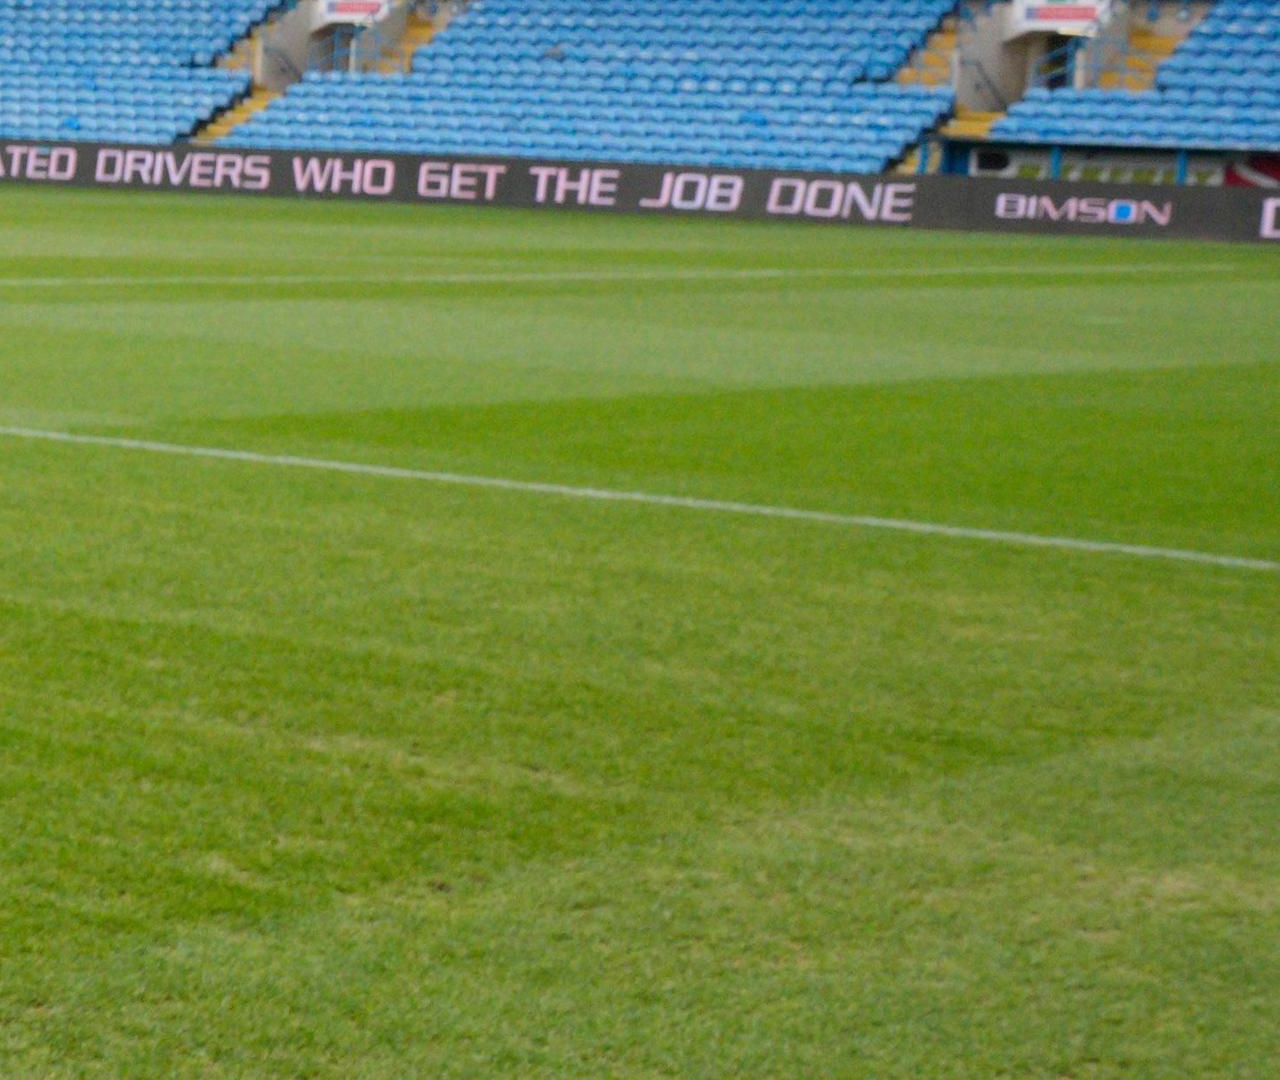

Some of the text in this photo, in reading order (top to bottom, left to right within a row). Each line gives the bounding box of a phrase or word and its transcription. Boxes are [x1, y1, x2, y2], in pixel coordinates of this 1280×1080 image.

[95, 148, 271, 190] DRIVERS
[292, 156, 395, 196] WHO
[417, 161, 507, 200] GET
[529, 166, 620, 206] THE
[639, 172, 745, 212] JOB
[765, 177, 916, 222] DONE
[995, 192, 1173, 226] BIMSON
